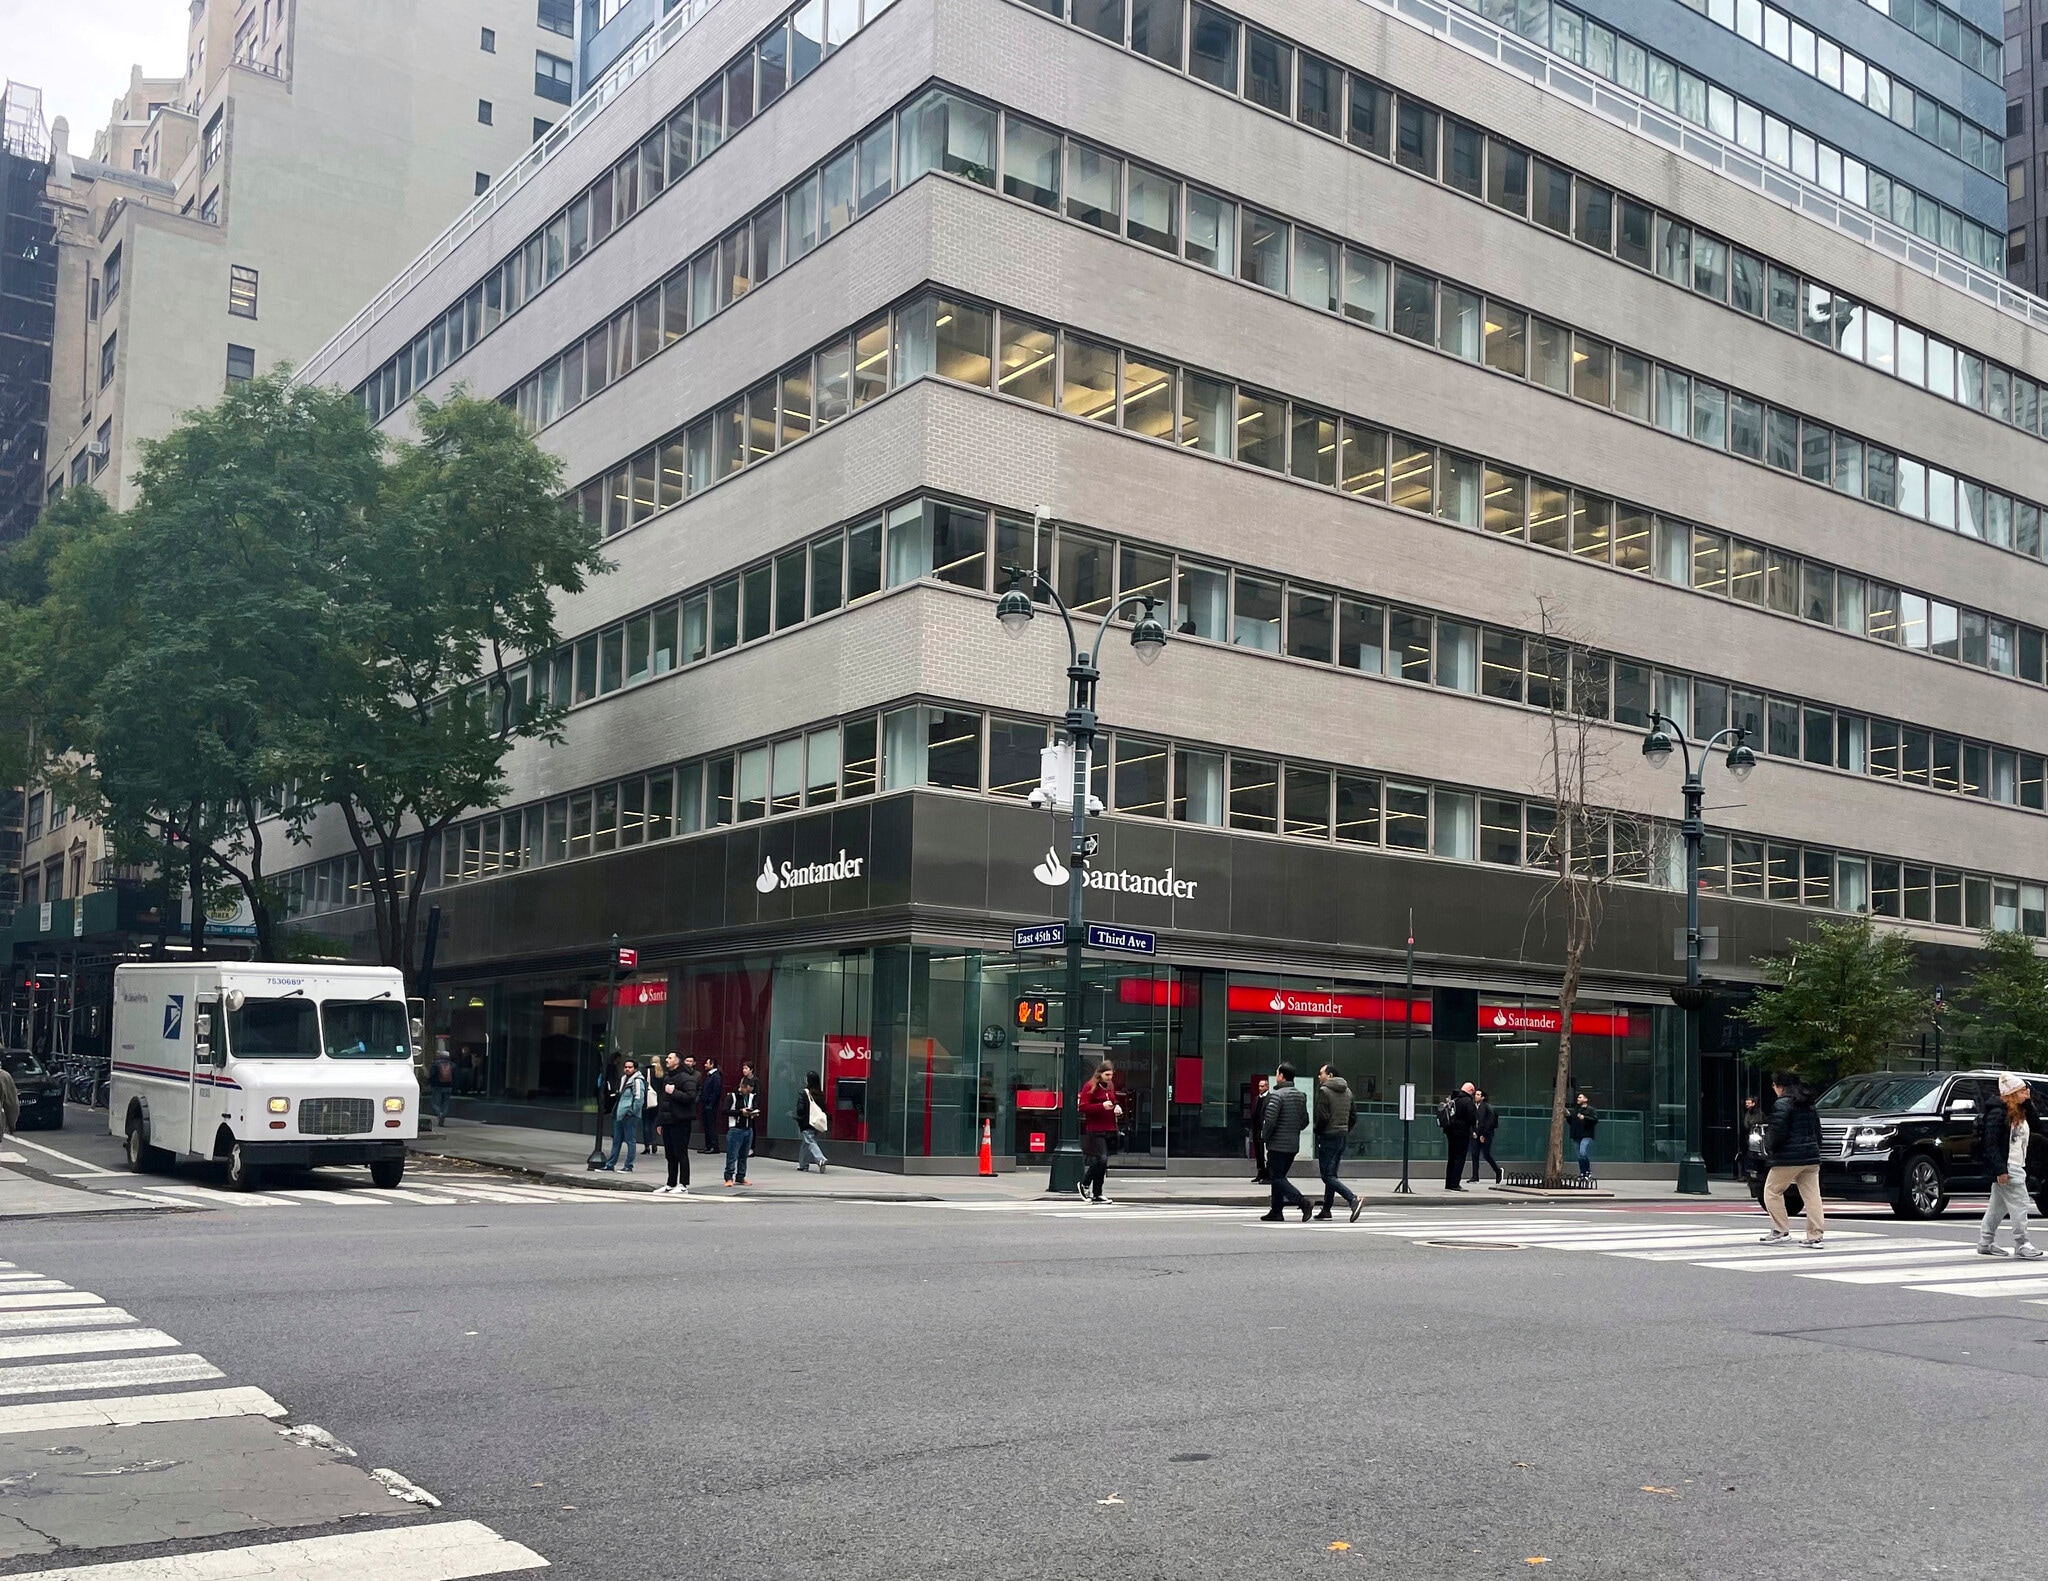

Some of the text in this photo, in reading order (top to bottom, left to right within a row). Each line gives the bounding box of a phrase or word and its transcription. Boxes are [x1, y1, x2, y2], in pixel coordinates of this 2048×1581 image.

[780, 848, 864, 889] Santander
[1017, 929, 1061, 945] East 45th St
[1097, 931, 1147, 949] Third Ave
[1287, 996, 1343, 1014] Santander
[1508, 1012, 1556, 1029] Santander
